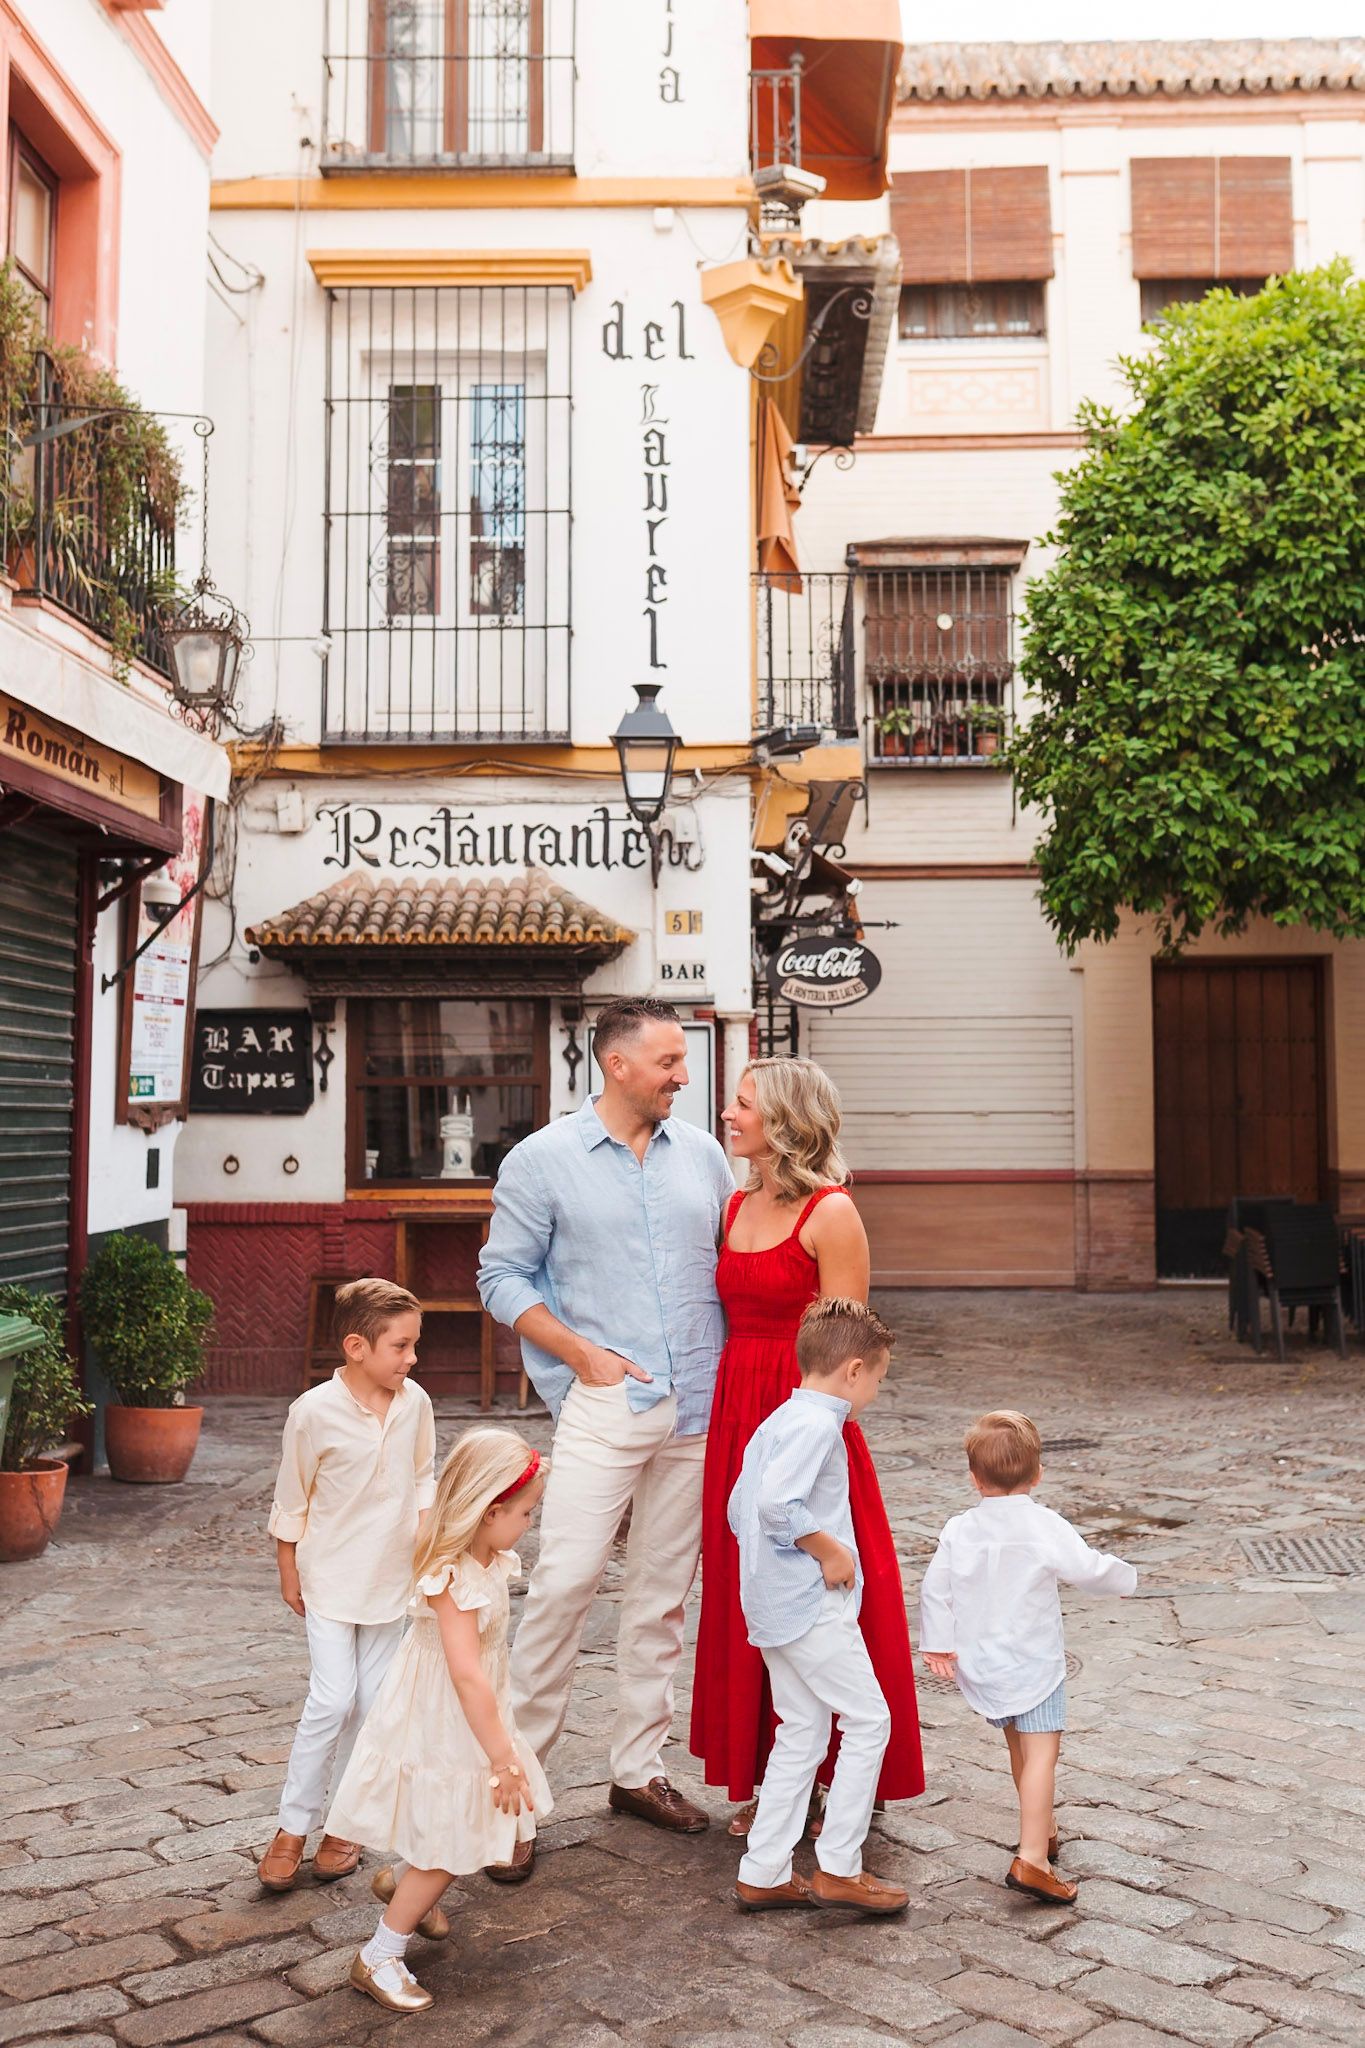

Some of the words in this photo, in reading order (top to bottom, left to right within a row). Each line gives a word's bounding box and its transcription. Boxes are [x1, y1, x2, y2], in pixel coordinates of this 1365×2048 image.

[602, 300, 695, 361] del
[639, 384, 669, 669] Laurel
[316, 802, 647, 872] Restaurante
[661, 963, 705, 980] BAR
[784, 982, 793, 994] LA
[202, 1026, 295, 1059] BAR
[201, 1063, 296, 1096] Tapas
